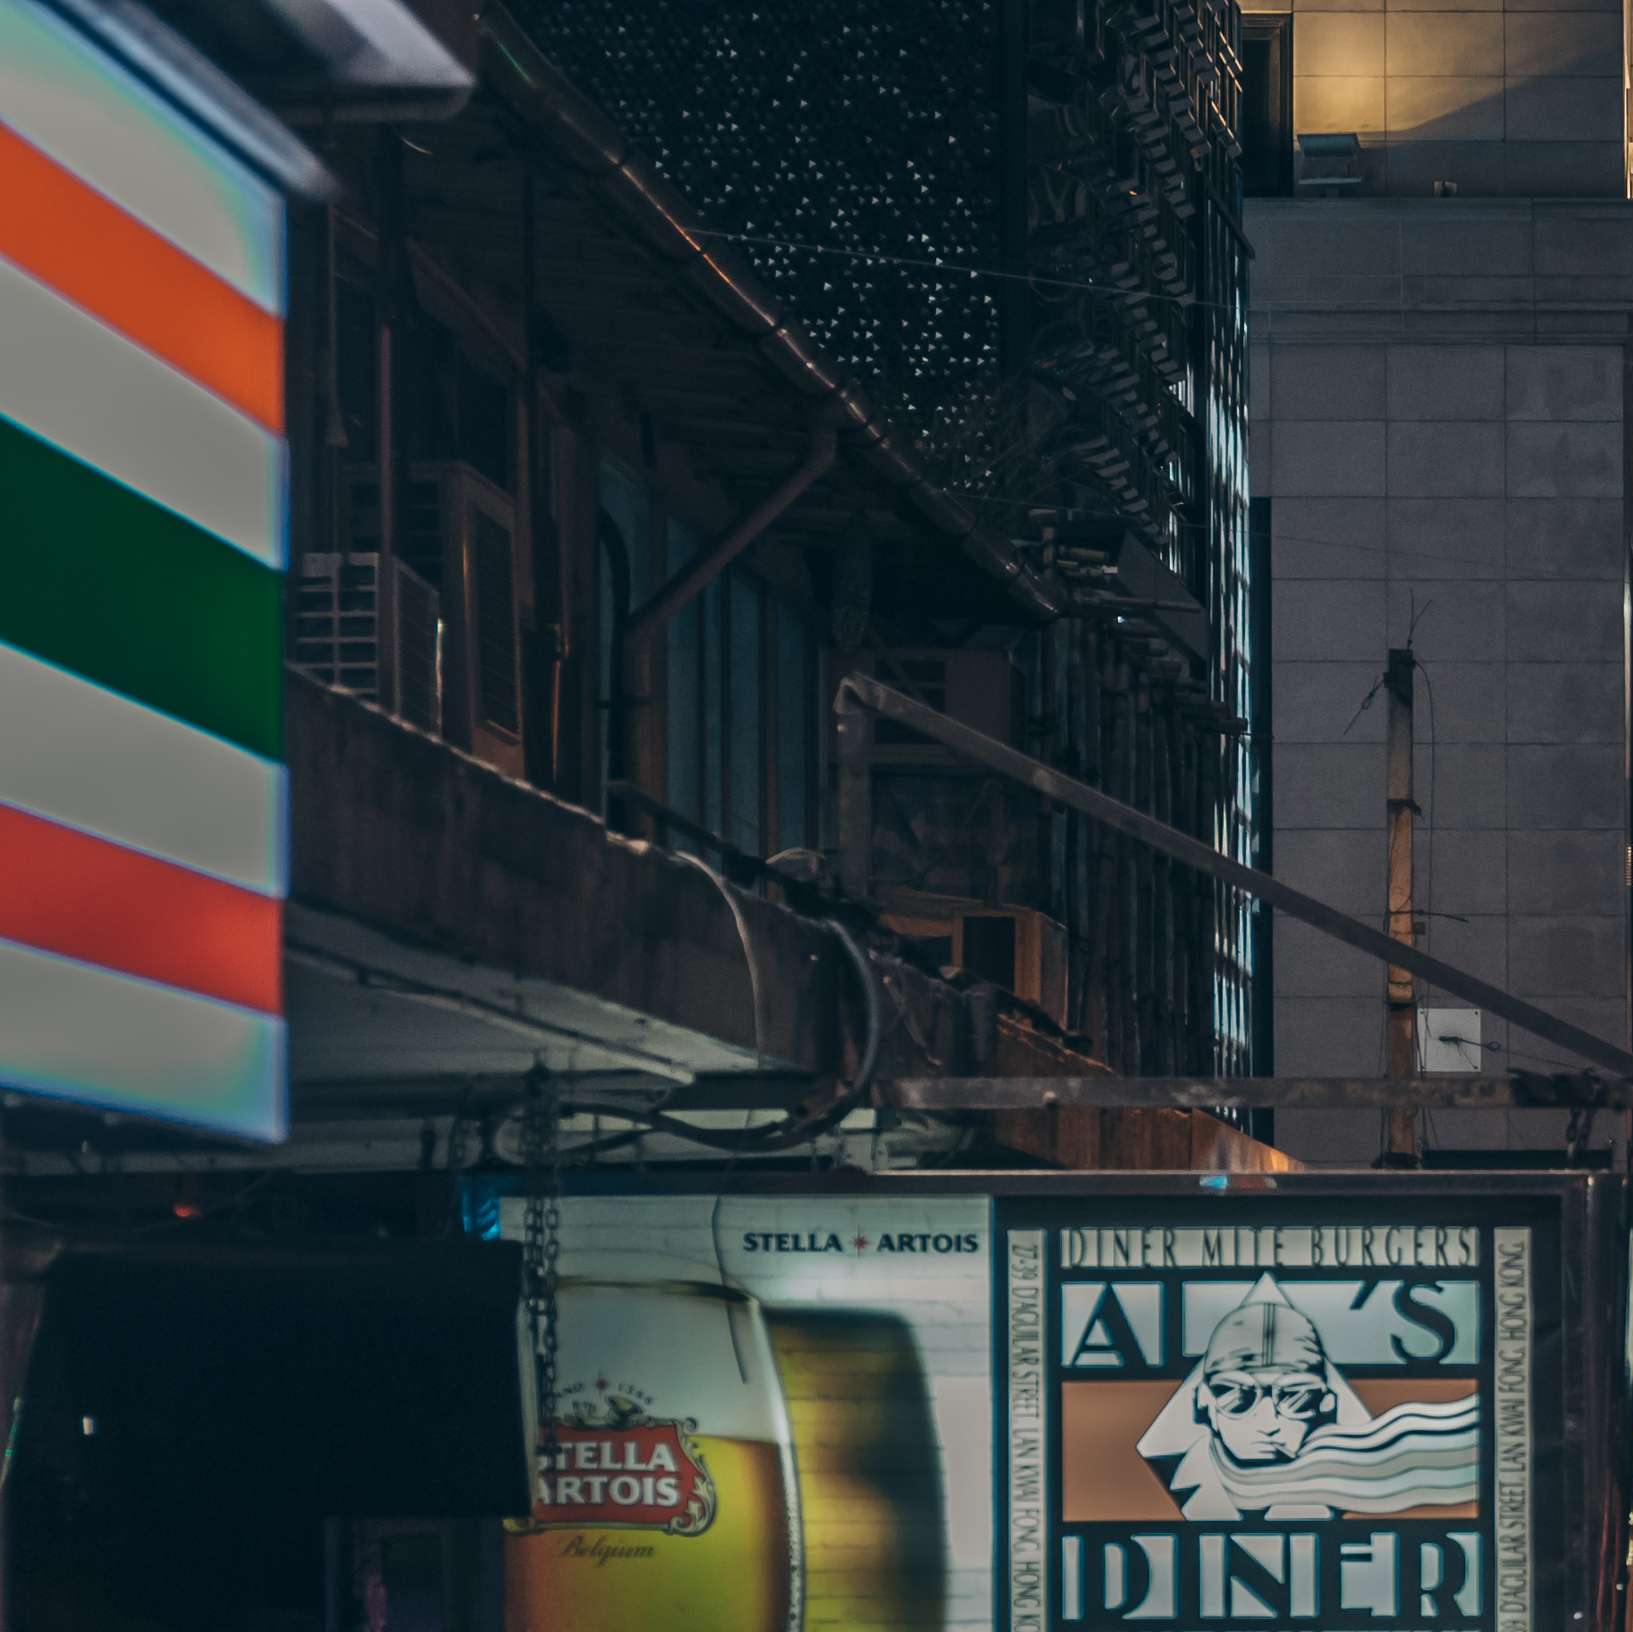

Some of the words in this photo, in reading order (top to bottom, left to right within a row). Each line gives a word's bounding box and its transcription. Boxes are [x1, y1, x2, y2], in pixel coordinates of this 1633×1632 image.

[743, 1232, 844, 1254] STELLA
[877, 1231, 979, 1254] ARTOIS
[1013, 1243, 1039, 1280] 27-39
[1066, 1228, 1180, 1267] DINER
[1203, 1228, 1284, 1267] MITE
[1311, 1227, 1474, 1267] BURGERS
[1013, 1287, 1039, 1364] D'AGUILAR
[1499, 1293, 1526, 1341] HONG
[1499, 1400, 1526, 1437] KWAI
[1014, 1428, 1039, 1457] LAN
[1499, 1443, 1526, 1473] LAN
[1014, 1464, 1039, 1500] KWAI
[1014, 1561, 1040, 1608] HONG
[1078, 1532, 1483, 1620] DINER
[1499, 1535, 1526, 1614] D'AGUILAR
